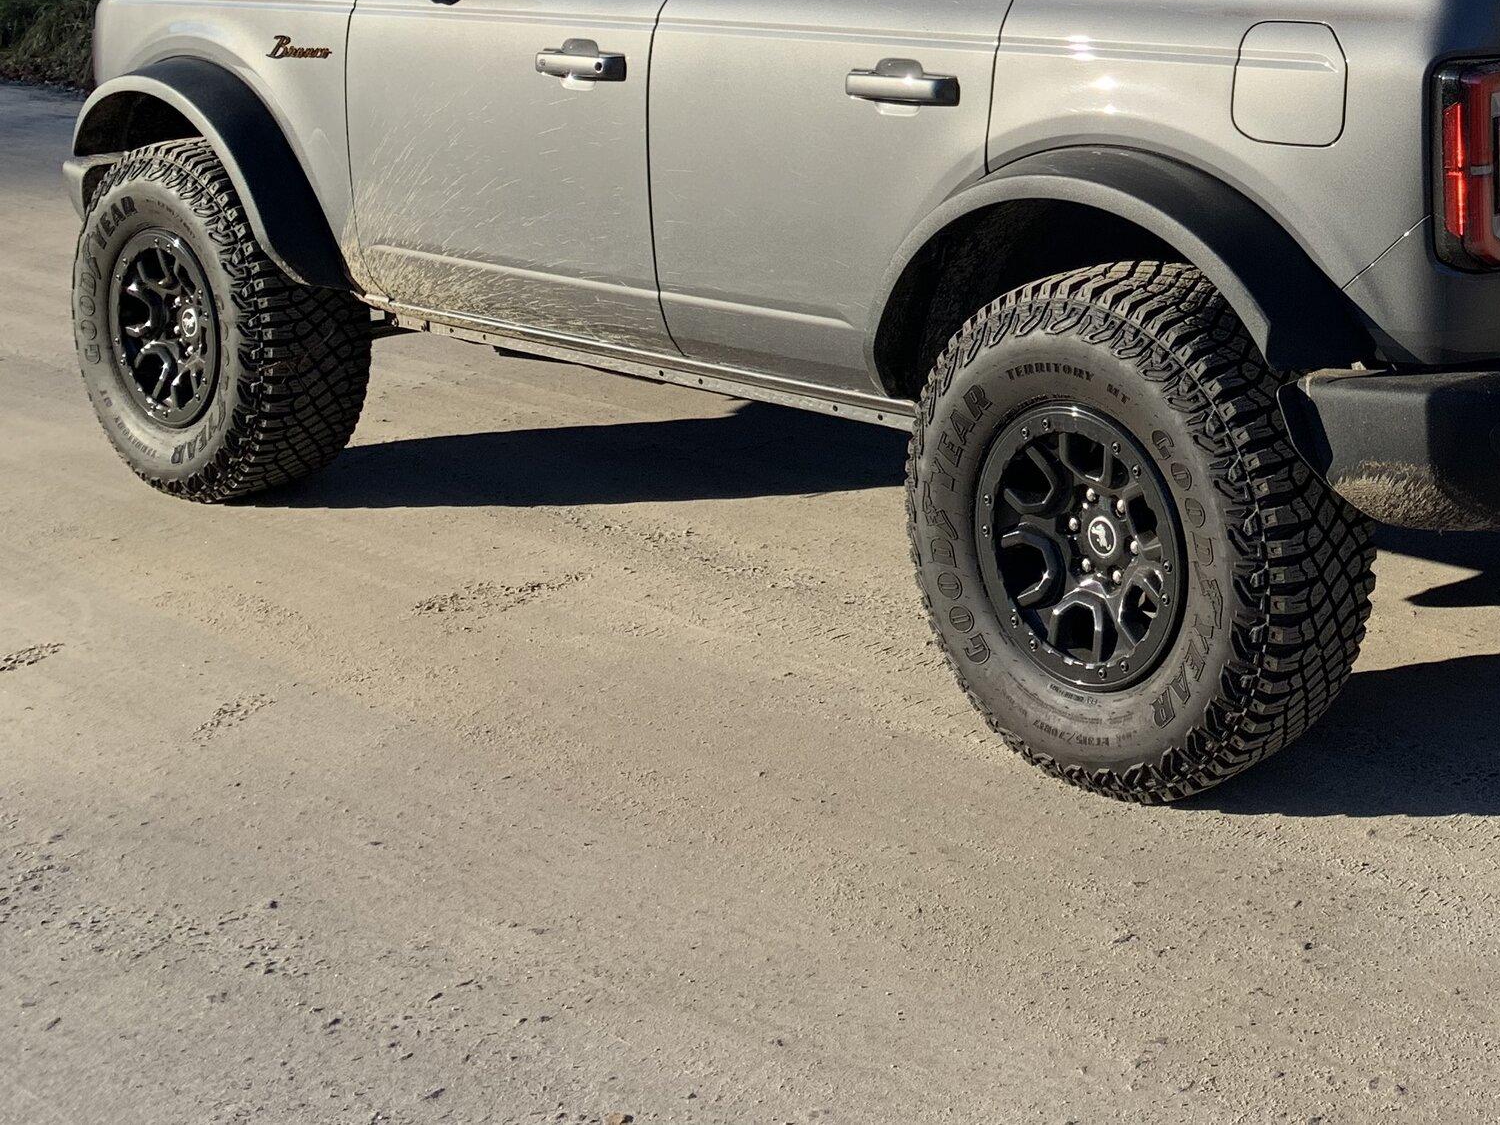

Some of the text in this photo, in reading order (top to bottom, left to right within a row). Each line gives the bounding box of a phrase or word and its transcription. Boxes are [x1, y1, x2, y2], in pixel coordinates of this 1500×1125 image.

[1005, 362, 1095, 382] TERRITORY
[919, 383, 994, 665] GOODYEAR
[1150, 429, 1224, 730] GOODYEAR
